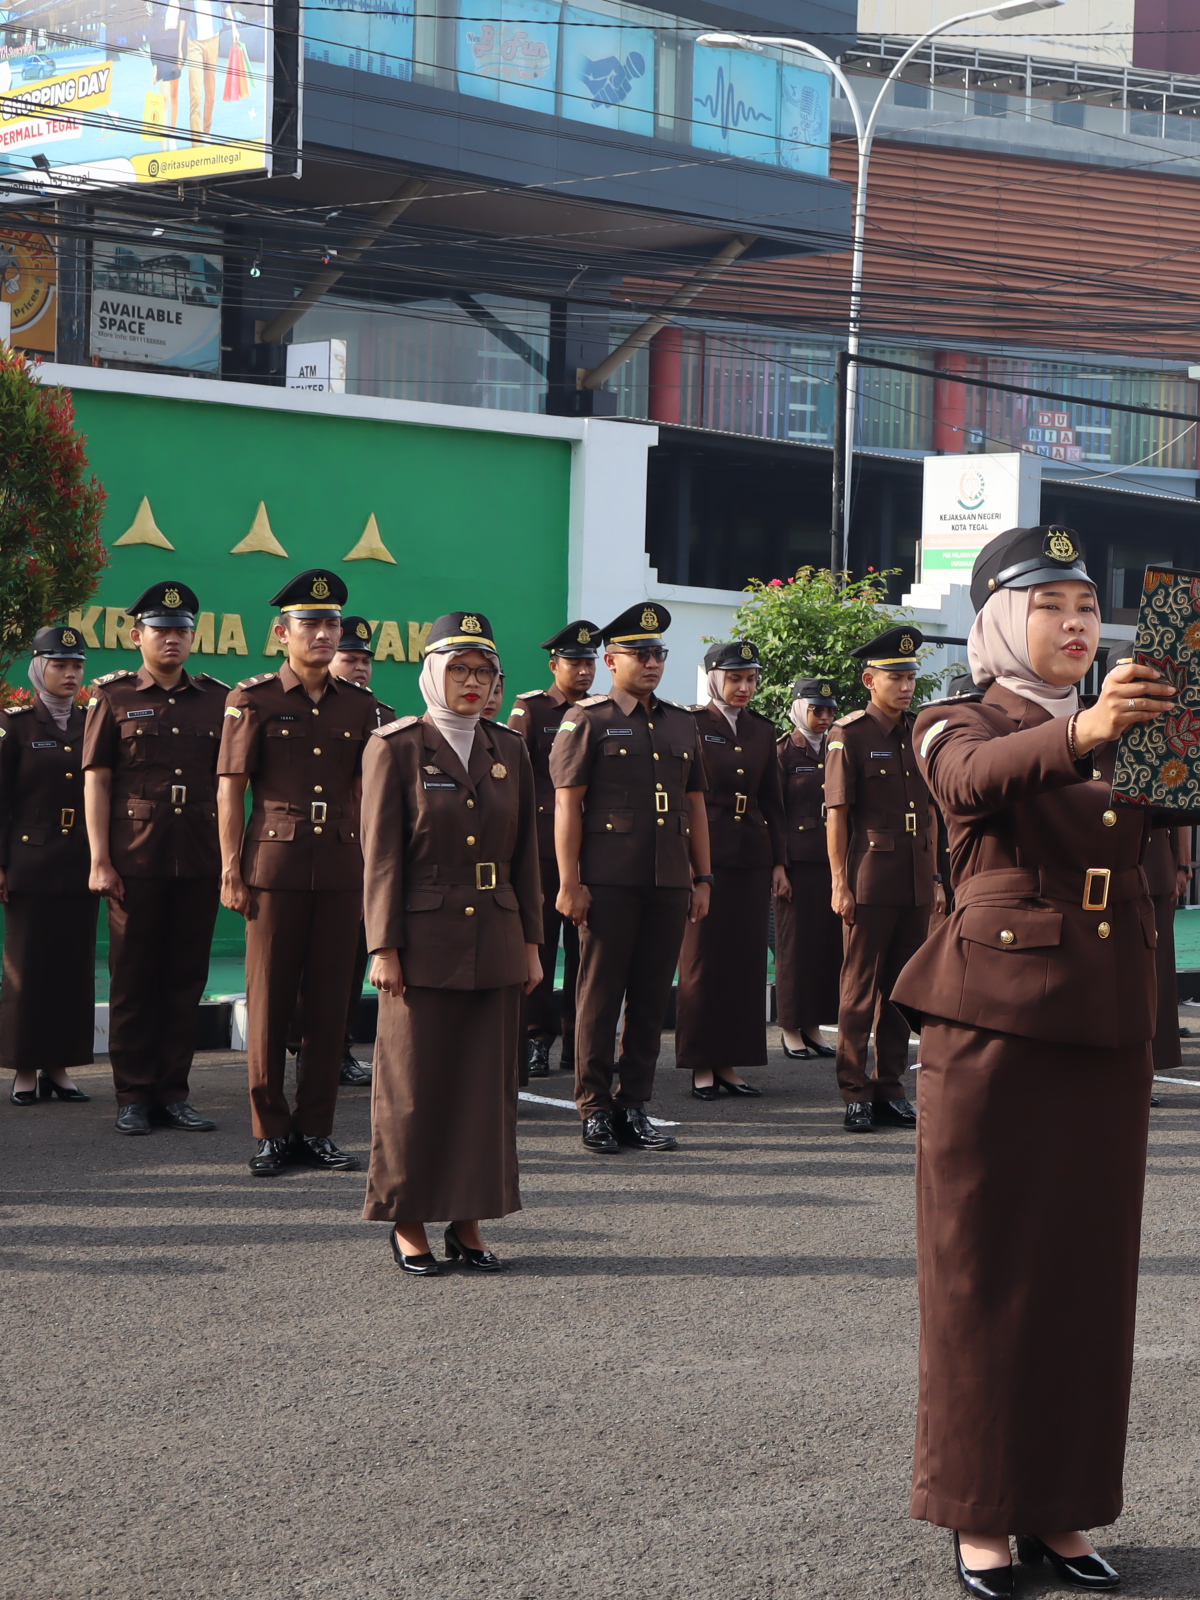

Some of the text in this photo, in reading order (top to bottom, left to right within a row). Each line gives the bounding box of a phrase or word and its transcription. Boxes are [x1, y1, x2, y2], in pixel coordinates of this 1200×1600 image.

[502, 31, 548, 61] Fun
[2, 67, 110, 121] SHOPPING DAY
[46, 117, 80, 134] TEGAL
[160, 152, 242, 173] @ritasupermalltegal
[13, 288, 40, 318] Prices
[99, 300, 183, 325] AVAILABLE
[98, 331, 114, 339] More
[99, 316, 146, 335] SPACE
[299, 365, 317, 378] ATM
[1023, 445, 1080, 460] ANAK
[940, 513, 976, 521] KEJAKSAAN
